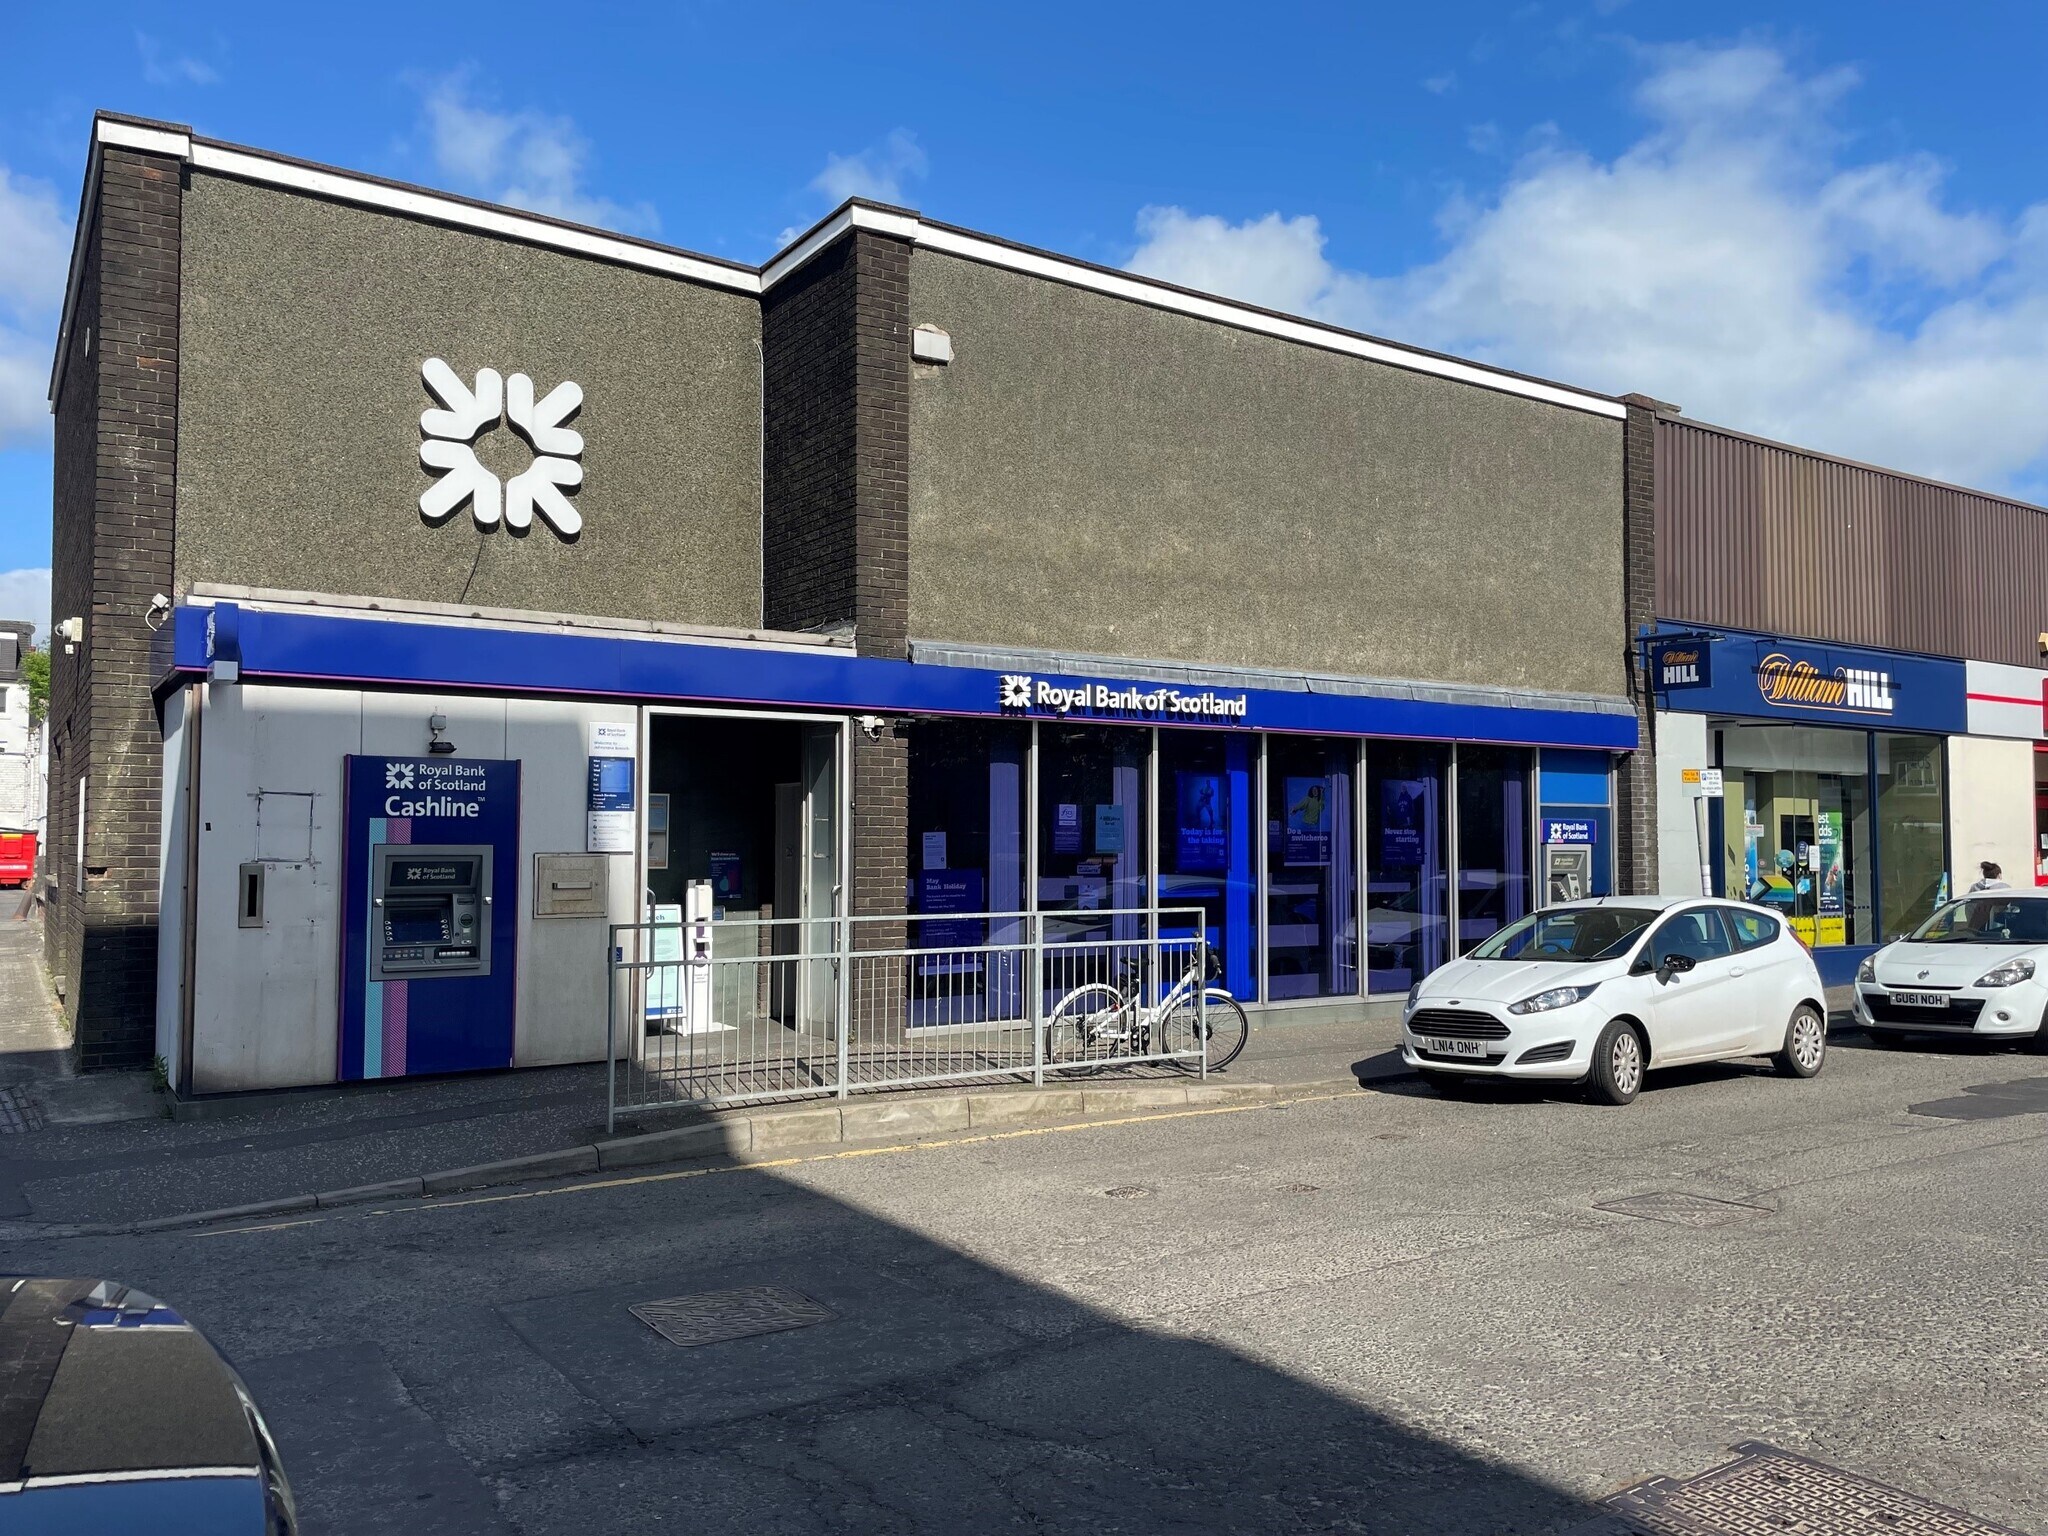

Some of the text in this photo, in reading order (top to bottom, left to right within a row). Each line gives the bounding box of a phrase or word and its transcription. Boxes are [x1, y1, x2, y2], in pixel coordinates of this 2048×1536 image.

[1663, 664, 1699, 684] HILL
[1758, 653, 1893, 710] William HILL
[1037, 681, 1247, 716] Royal Bank of Scotland
[419, 764, 485, 778] Royal Bank
[418, 779, 486, 791] of Scotland
[385, 796, 479, 817] Cashline
[1181, 828, 1203, 837] Today
[1404, 828, 1416, 836] stop
[1563, 823, 1575, 832] Royal
[1292, 834, 1328, 842] switcheroo
[1396, 836, 1419, 844] starting
[1896, 993, 1942, 1005] GU61 NOH
[1432, 1039, 1479, 1054] LN14 ONH
